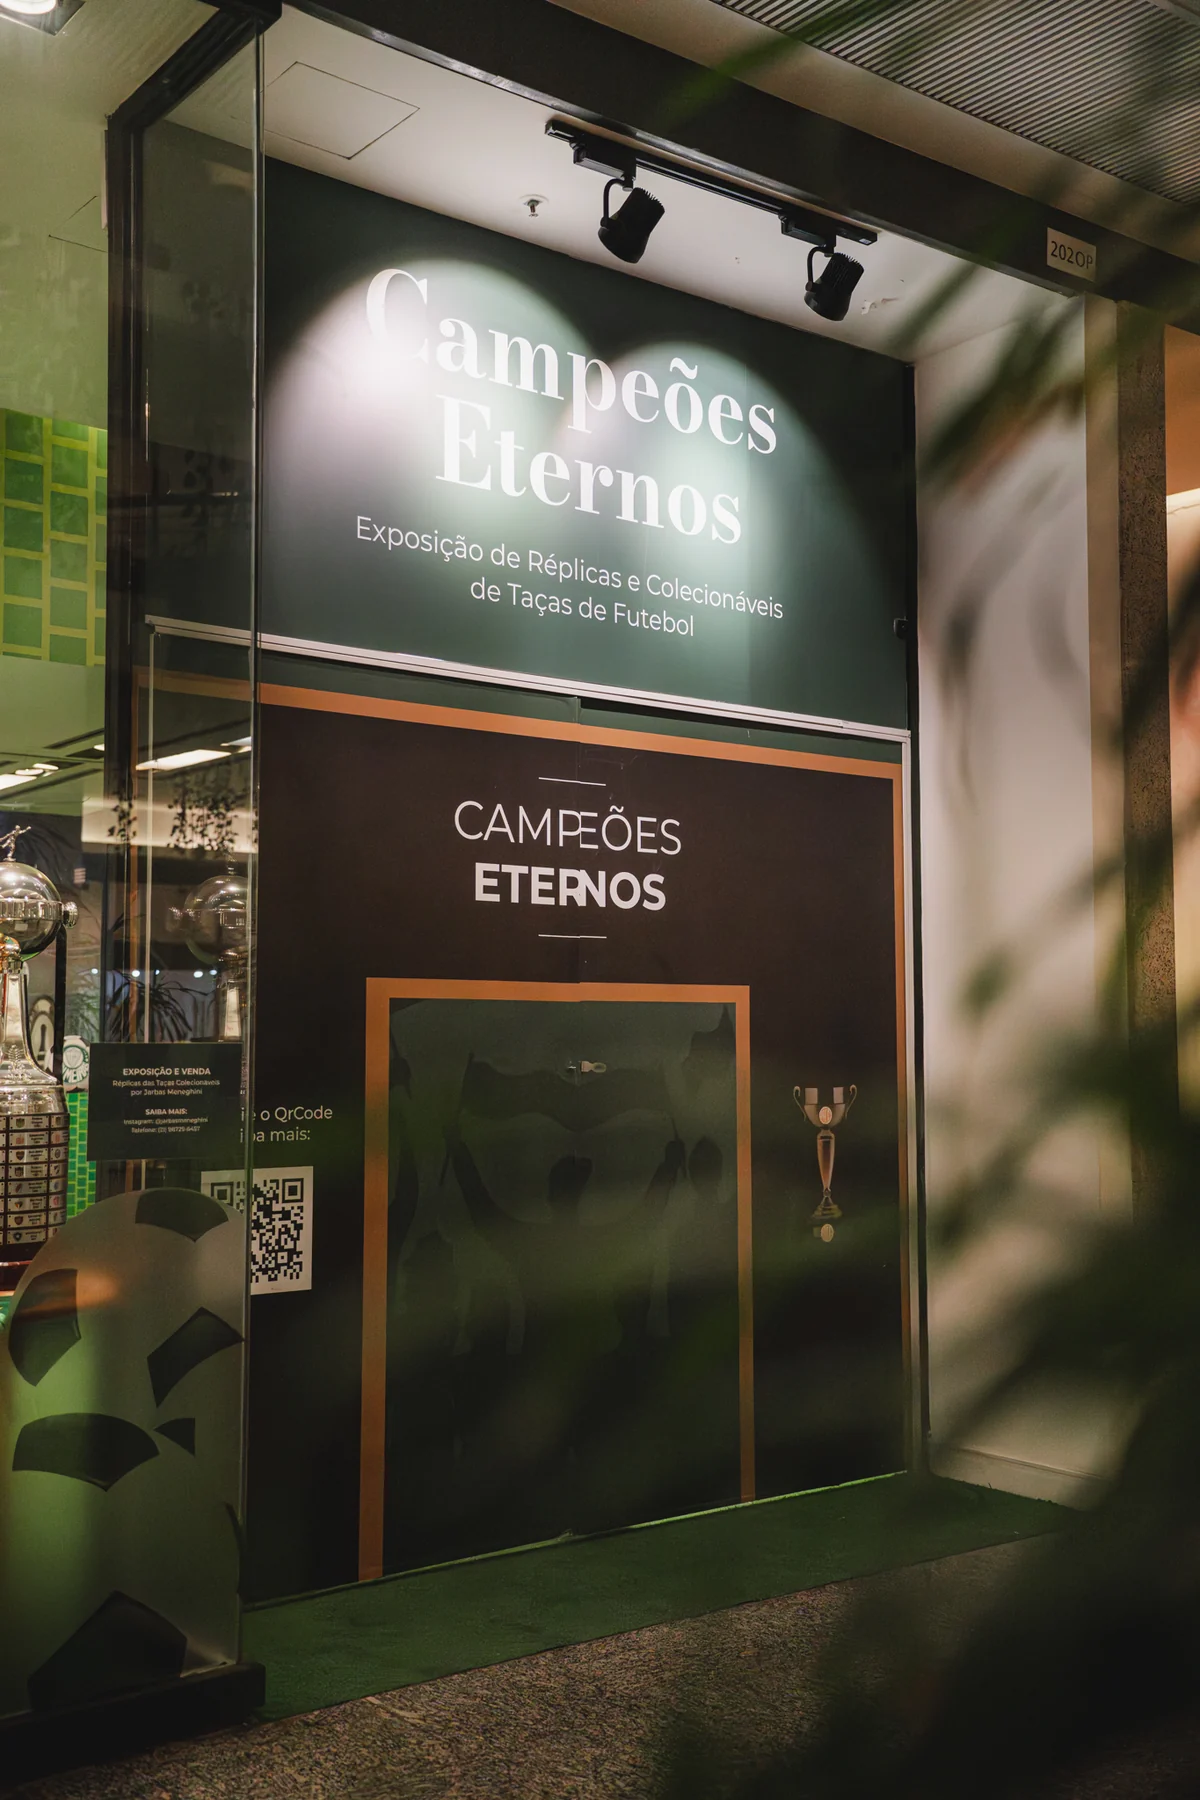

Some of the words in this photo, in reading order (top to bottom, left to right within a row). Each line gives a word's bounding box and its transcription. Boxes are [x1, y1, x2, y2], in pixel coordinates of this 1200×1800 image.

[366, 268, 777, 455] Campeões
[435, 394, 742, 544] Eternos
[356, 515, 484, 562] Exposição
[490, 543, 521, 568] de
[528, 550, 622, 588] Réplicas
[627, 575, 641, 592] e
[646, 574, 784, 619] Colecionáveis
[470, 576, 501, 602] de
[507, 582, 573, 617] Taças
[578, 596, 607, 621] de
[614, 602, 694, 637] Futebol
[454, 800, 682, 856] CAMPEÕES
[475, 862, 666, 911] ETERNOS
[122, 1067, 173, 1078] EXPOSIÇÃO
[181, 1067, 212, 1075] VENDA
[260, 1110, 270, 1120] o
[274, 1105, 333, 1122] QrCode
[270, 1126, 311, 1141] mais:
